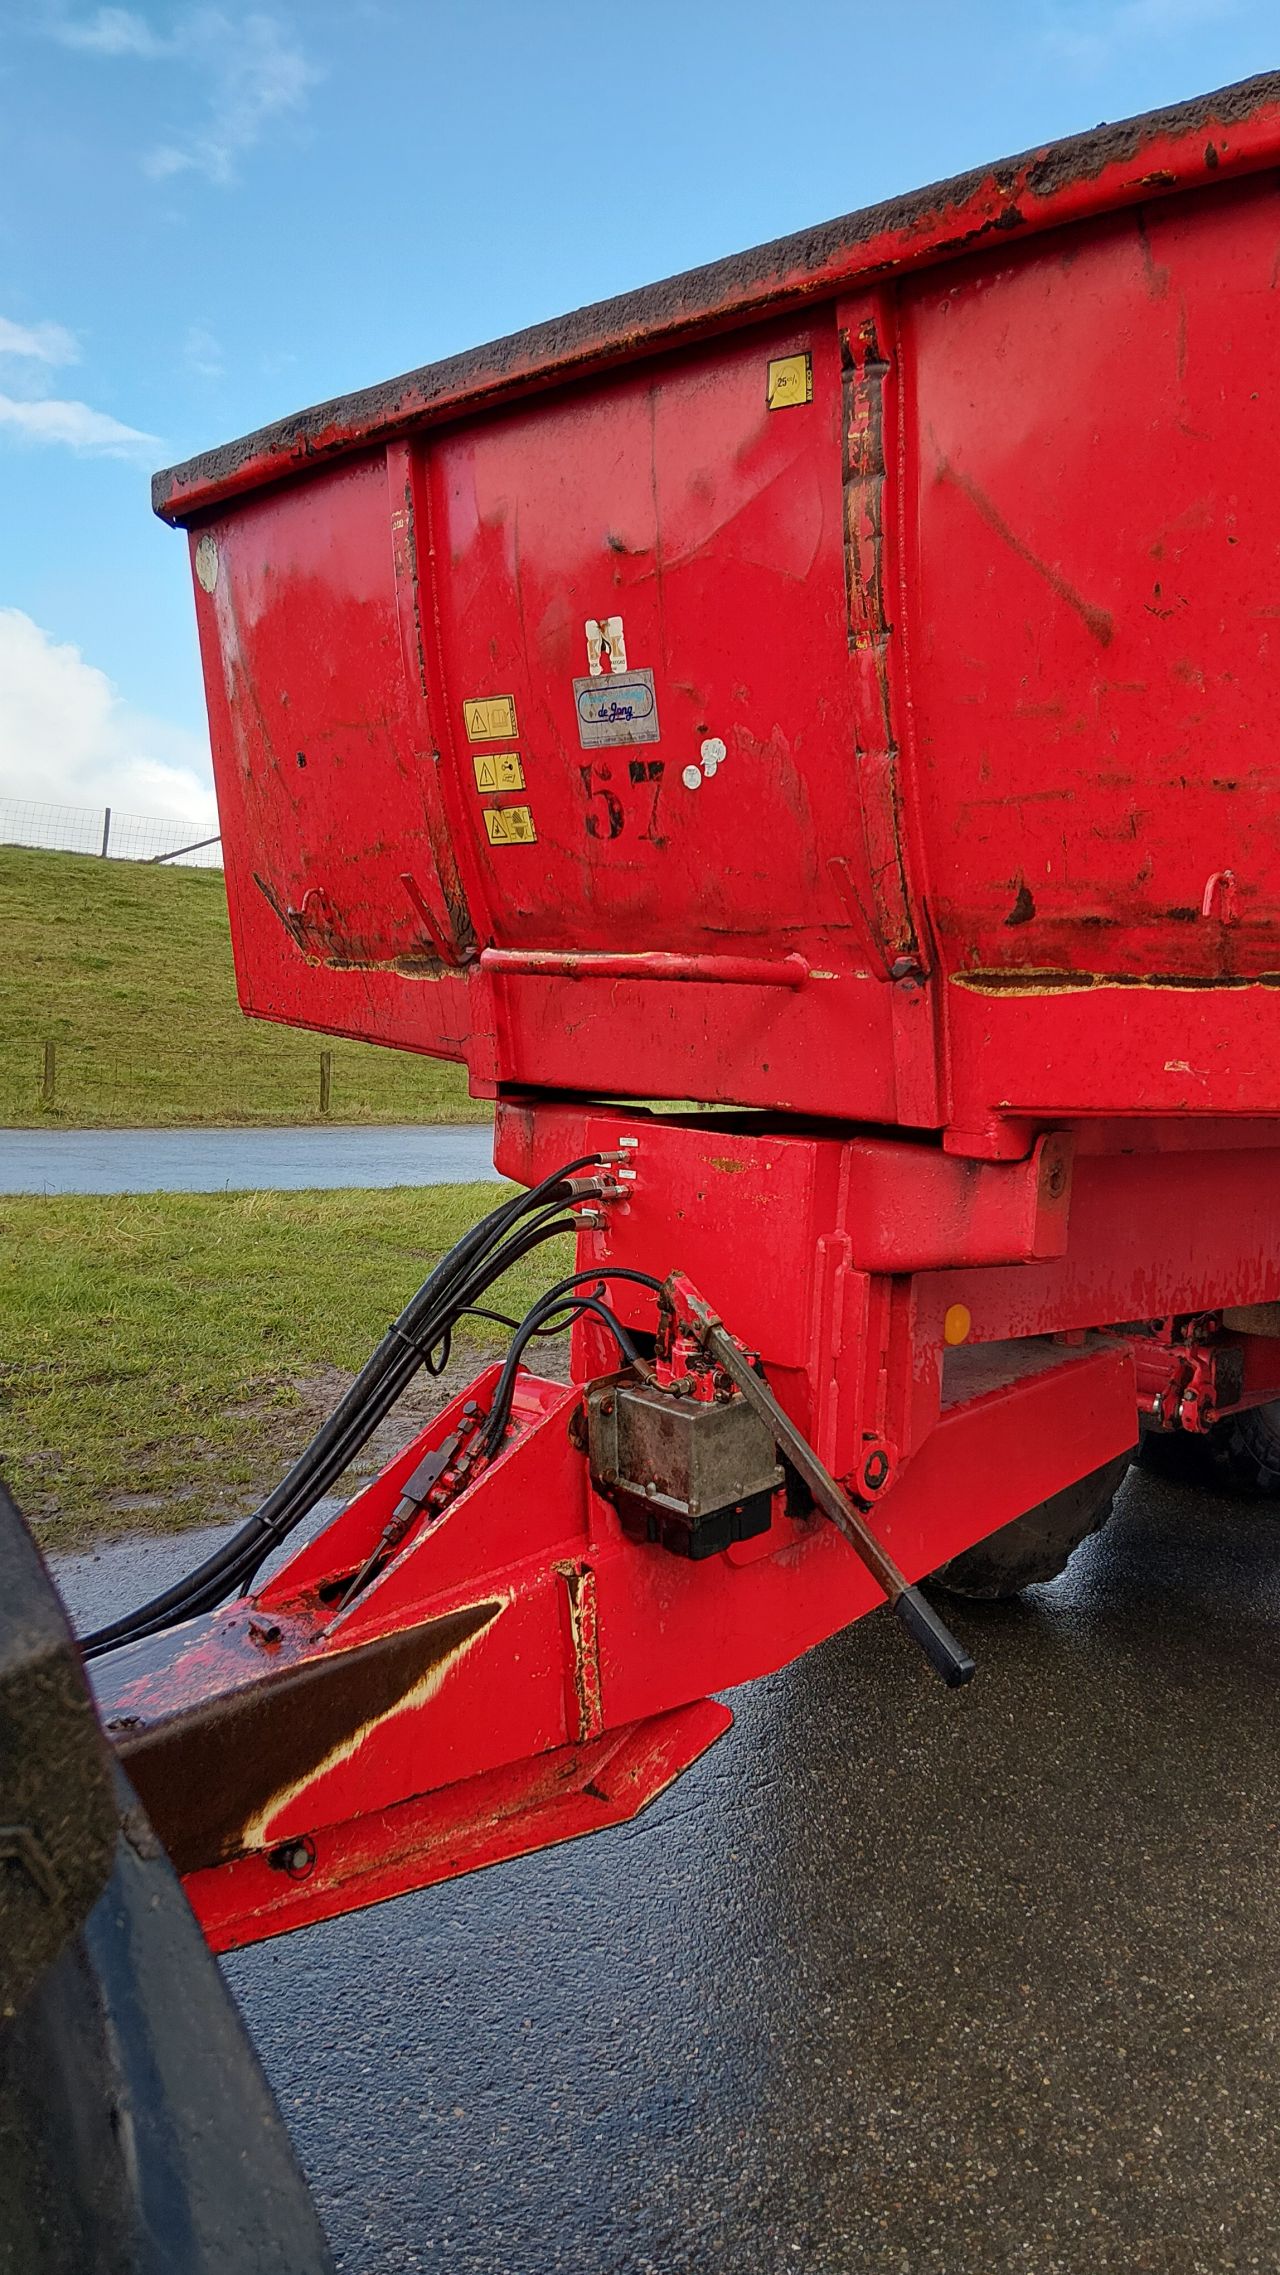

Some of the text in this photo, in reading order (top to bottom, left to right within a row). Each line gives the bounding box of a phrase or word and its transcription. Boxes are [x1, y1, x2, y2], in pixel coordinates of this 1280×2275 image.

[777, 376, 787, 388] 25
[597, 702, 609, 718] de
[579, 760, 666, 840] 57
